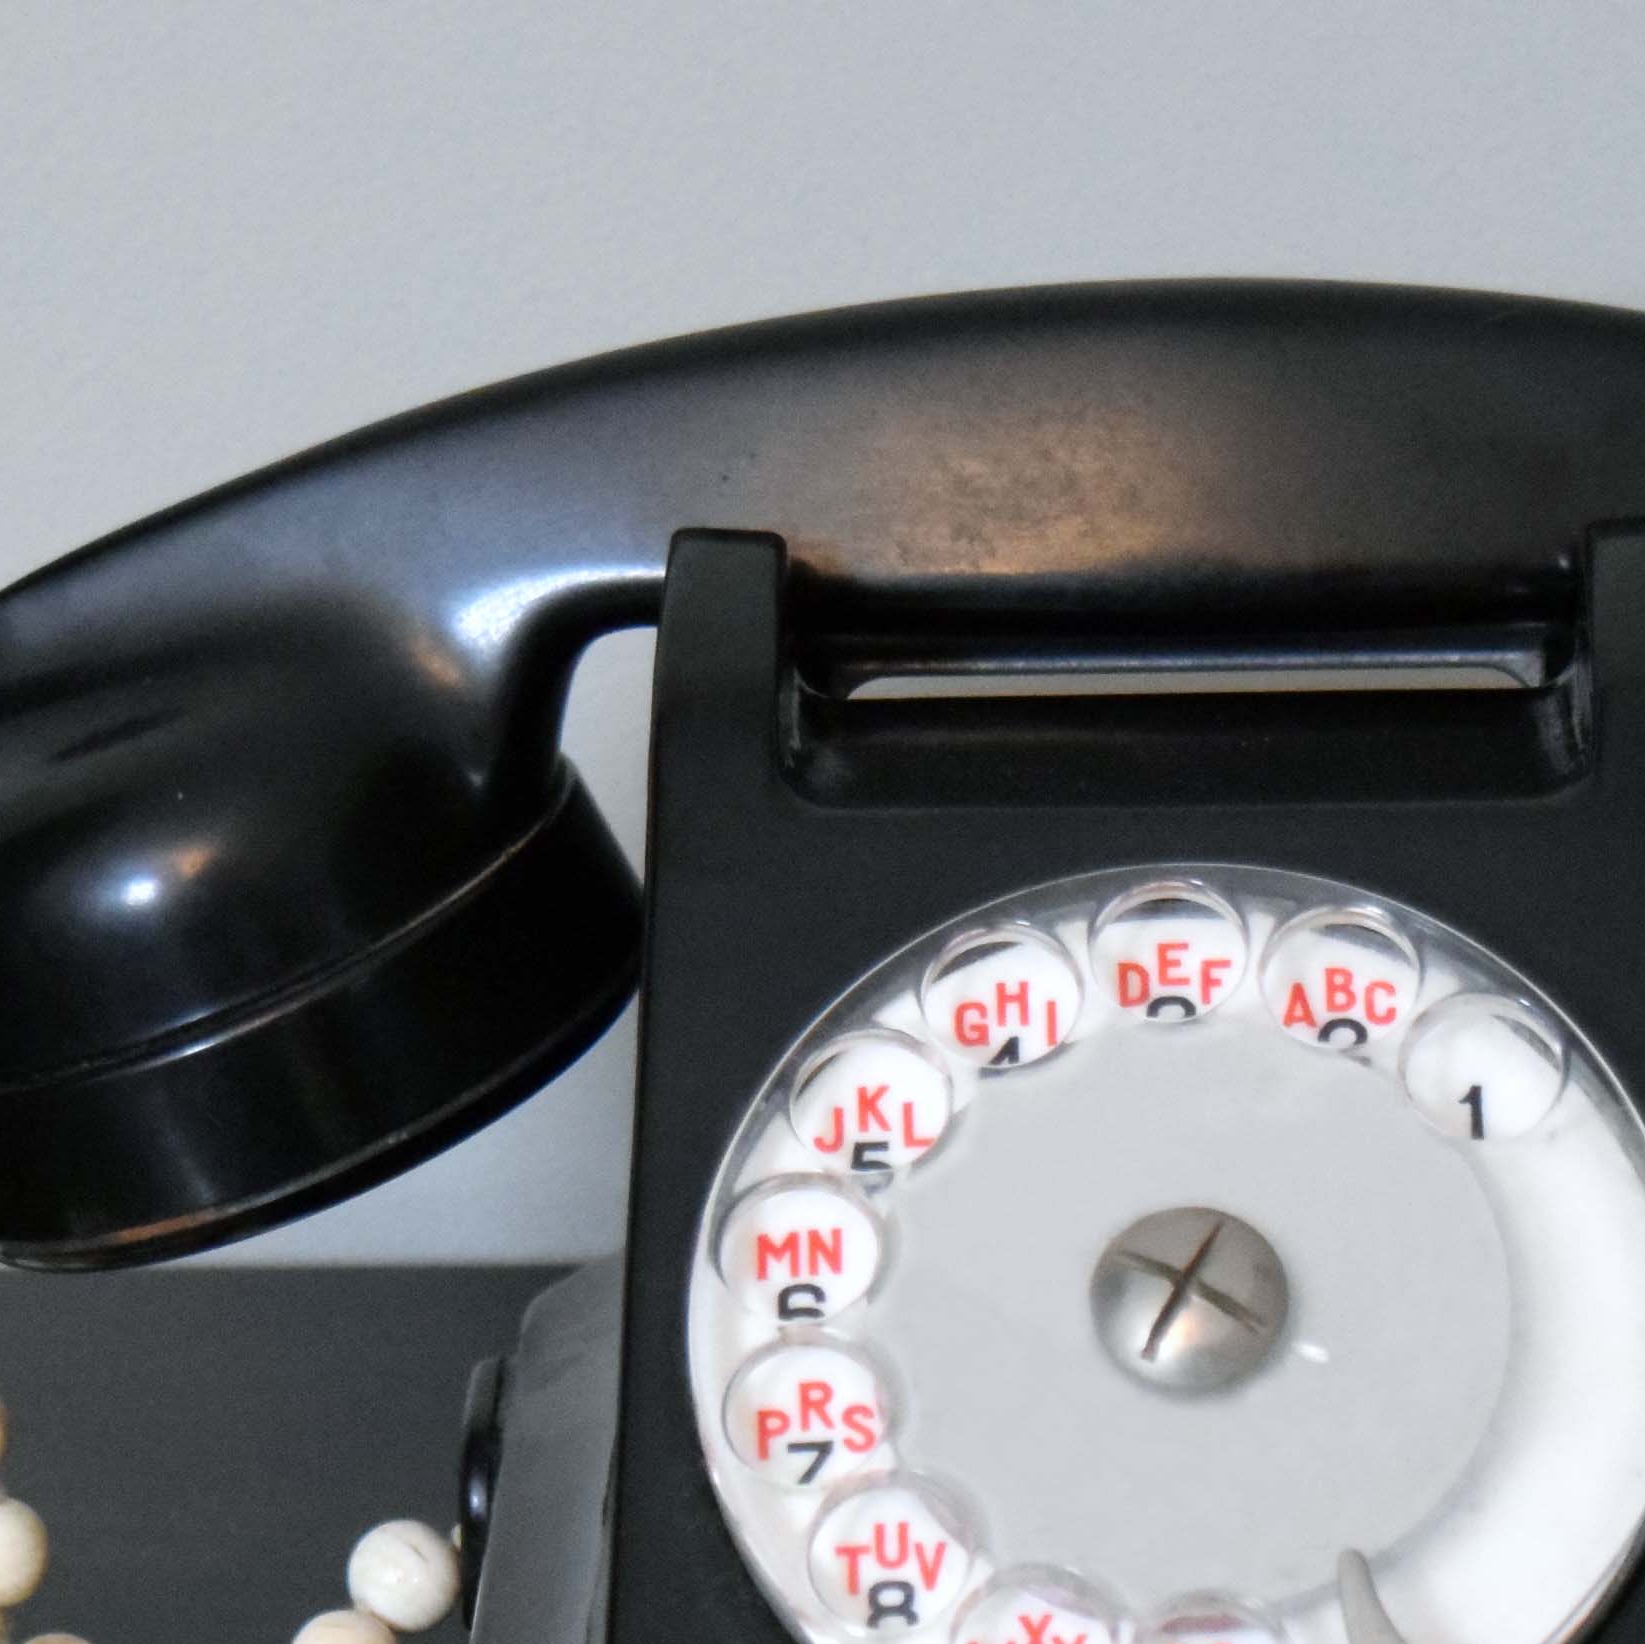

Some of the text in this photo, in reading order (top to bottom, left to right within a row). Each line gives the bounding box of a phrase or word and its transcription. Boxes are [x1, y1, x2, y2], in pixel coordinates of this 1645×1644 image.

[1114, 941, 1232, 1009] DEF
[1280, 965, 1398, 1029] ABC
[952, 980, 1059, 1049] GHI
[812, 1084, 934, 1154] JKL
[1459, 1084, 1484, 1140] 1
[754, 1227, 844, 1281] MN
[754, 1379, 878, 1462] PRS
[787, 1440, 834, 1487] 7
[834, 1521, 948, 1596] TUV
[866, 1580, 919, 1630] 8
